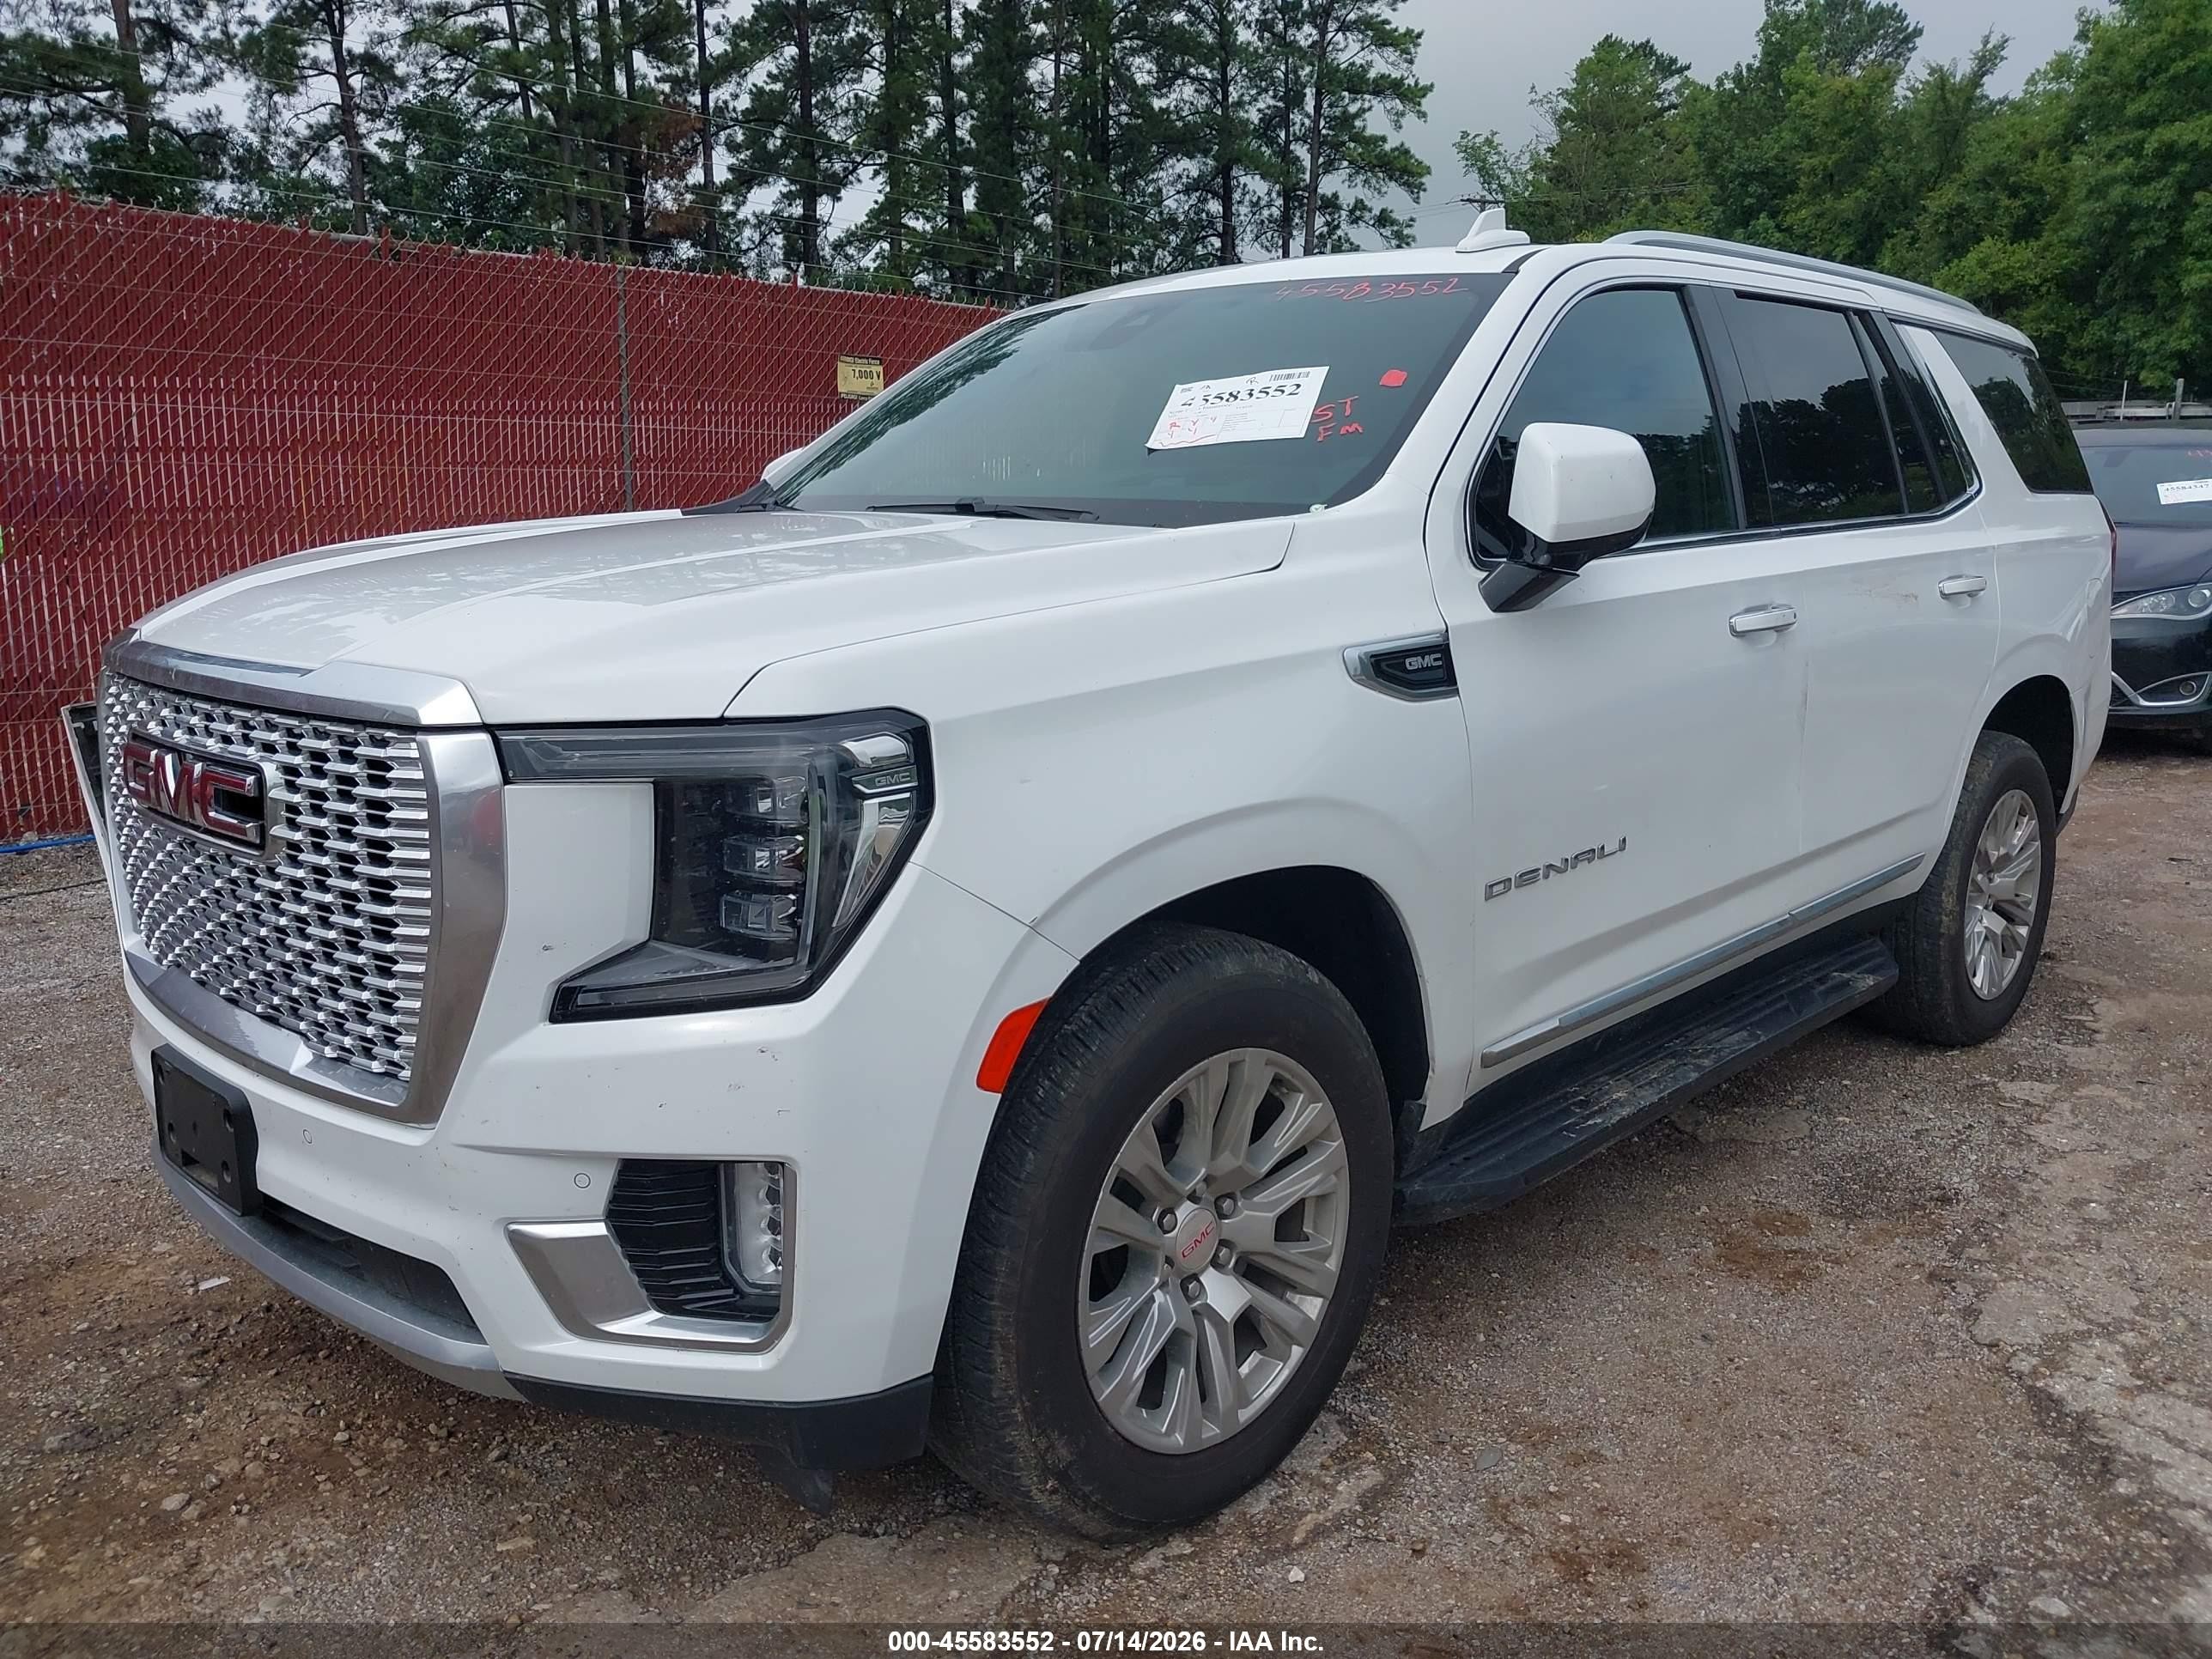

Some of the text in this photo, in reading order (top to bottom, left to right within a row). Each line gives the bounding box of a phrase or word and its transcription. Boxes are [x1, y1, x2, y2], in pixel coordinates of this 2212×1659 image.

[1275, 277, 1469, 303] 45583552
[851, 368, 881, 380] 7,000 V
[1310, 395, 1359, 423] ST
[1405, 653, 1443, 671] GMC
[123, 741, 258, 844] GMC
[875, 772, 911, 787] GMC
[1484, 836, 1627, 902] DENALI
[1181, 1221, 1215, 1259] GMC
